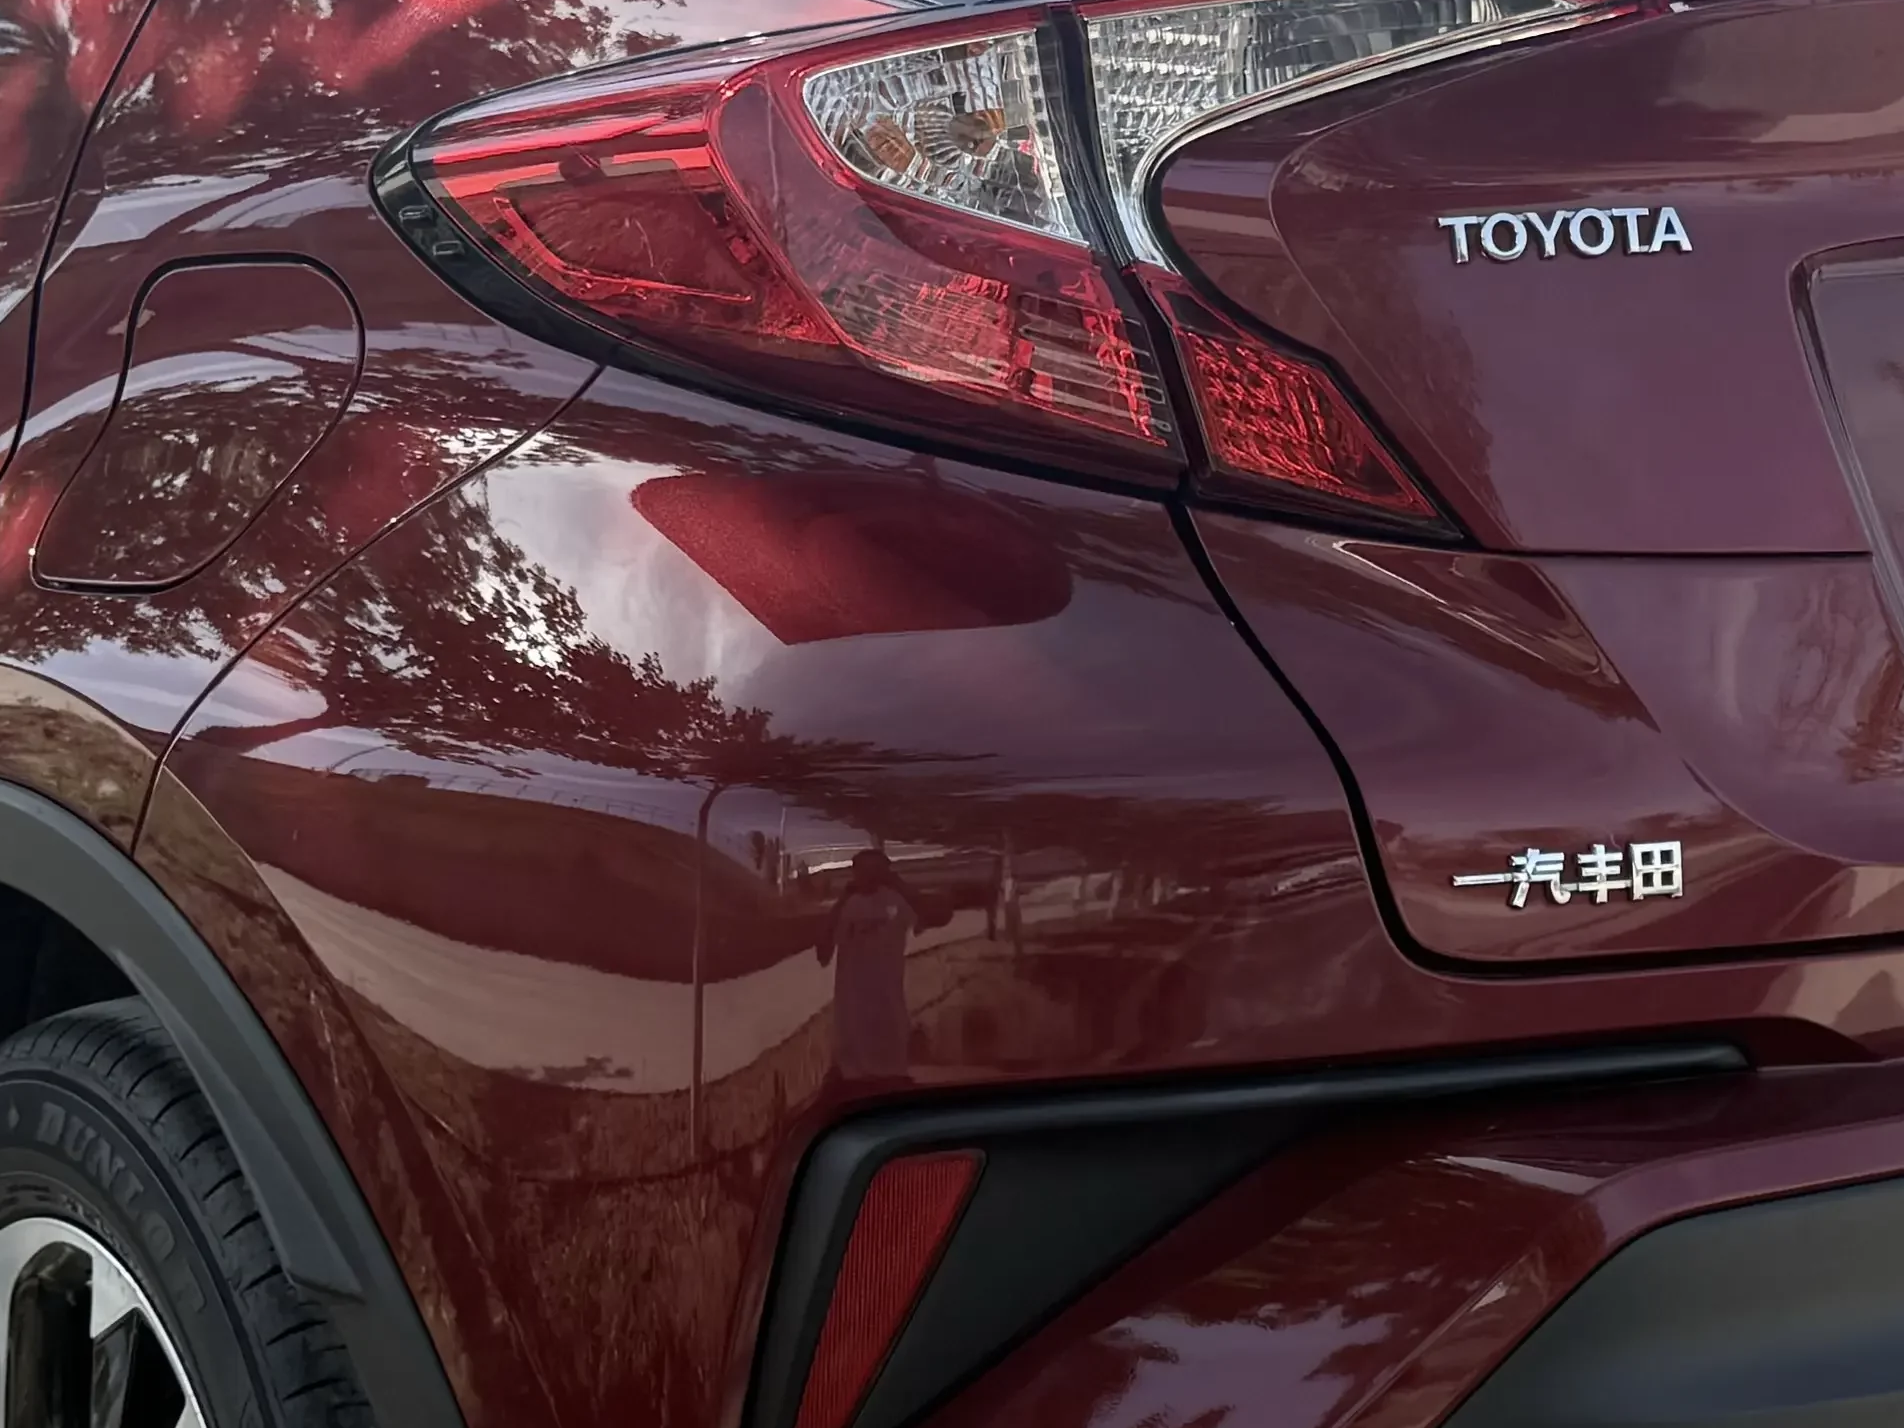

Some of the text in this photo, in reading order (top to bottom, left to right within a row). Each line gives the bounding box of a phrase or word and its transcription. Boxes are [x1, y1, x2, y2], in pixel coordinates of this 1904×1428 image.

[1438, 206, 1694, 265] TOYOTA
[1452, 840, 1684, 909] 一汽丰田
[36, 1101, 208, 1314] DUNLOP
